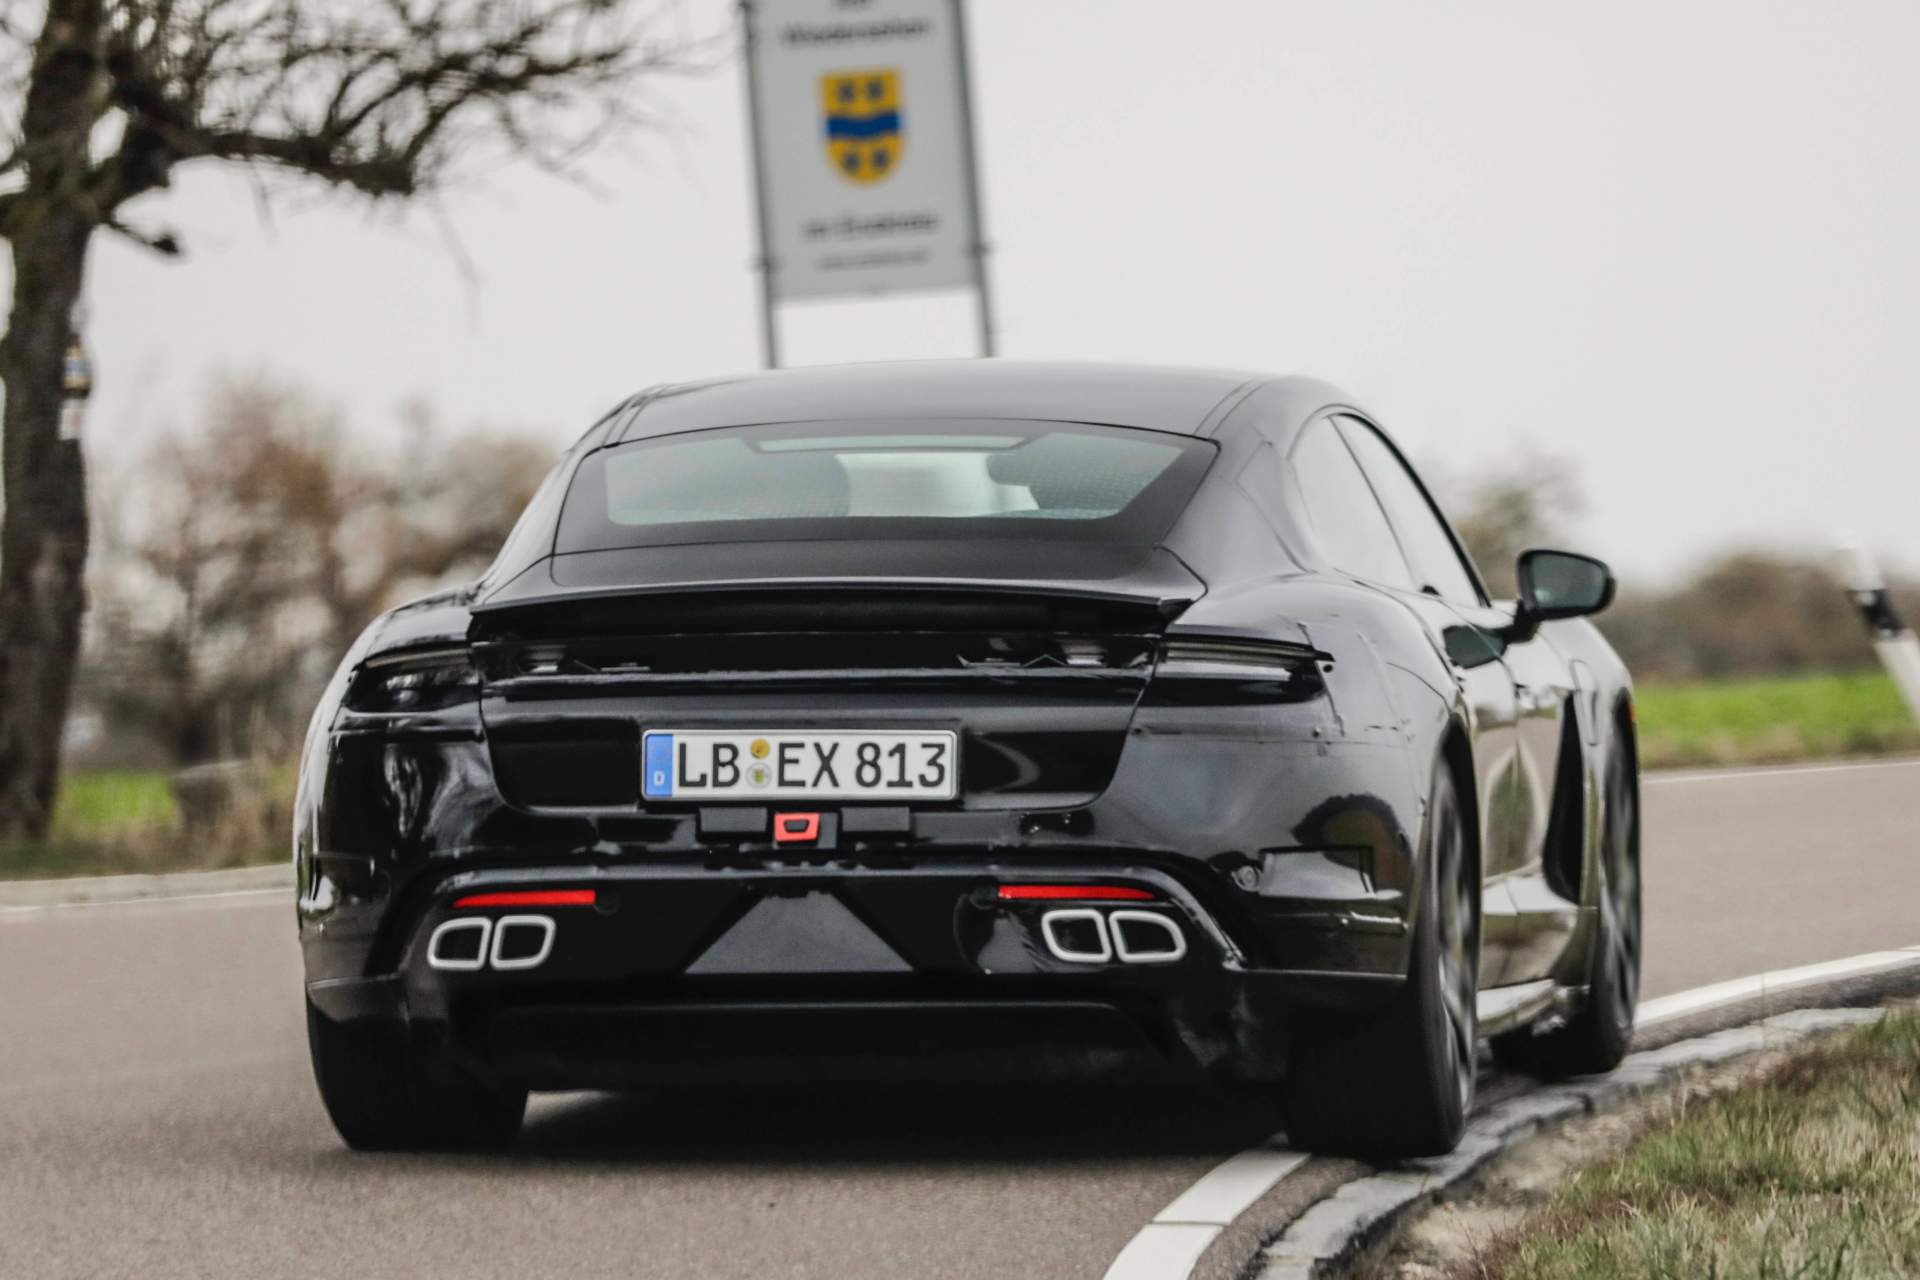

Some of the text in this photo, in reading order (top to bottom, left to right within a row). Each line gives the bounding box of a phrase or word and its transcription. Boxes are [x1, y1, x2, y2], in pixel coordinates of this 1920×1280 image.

[653, 771, 665, 786] D
[678, 743, 946, 787] LB EX 813
